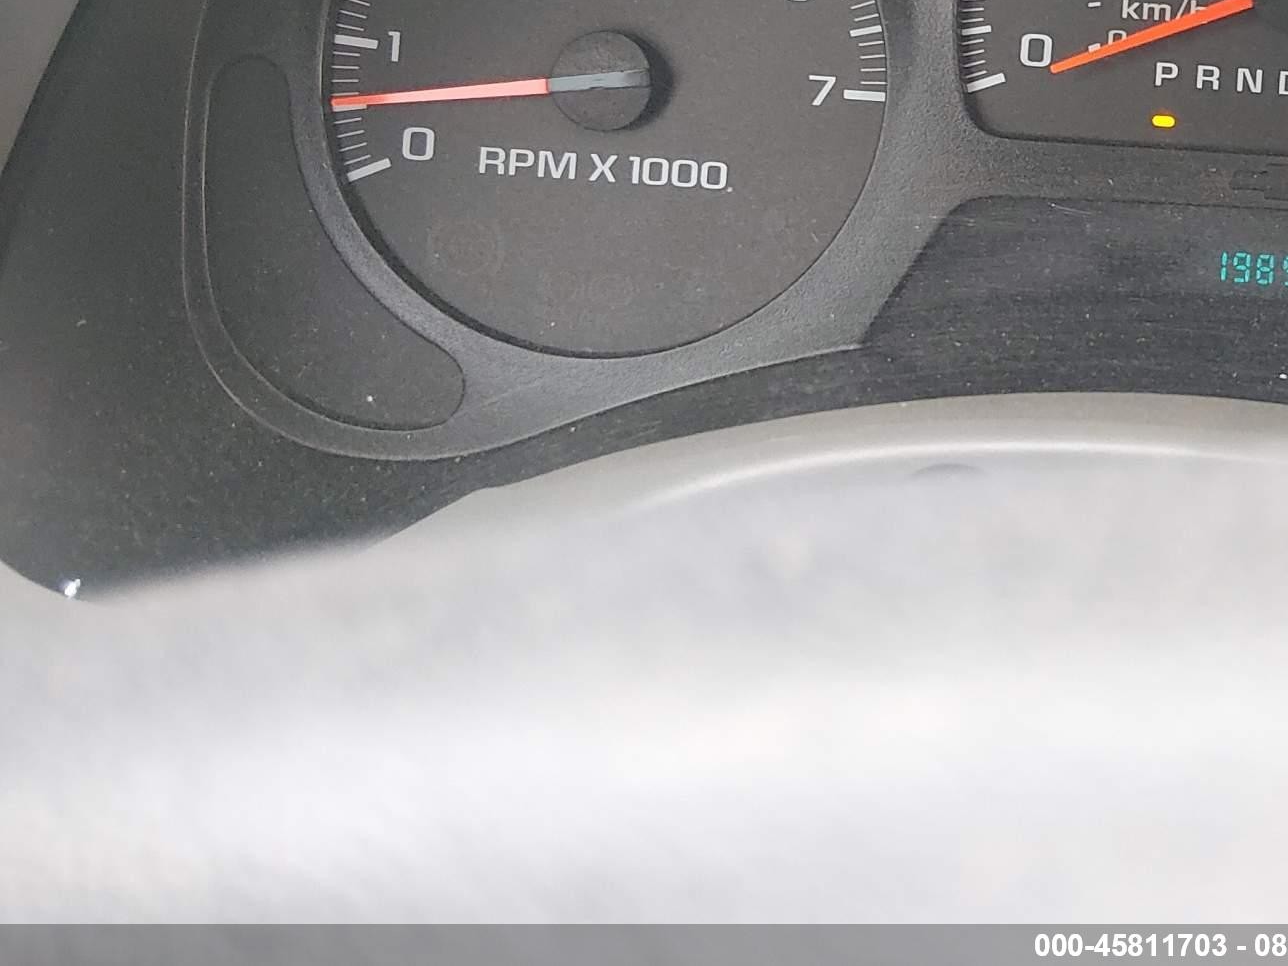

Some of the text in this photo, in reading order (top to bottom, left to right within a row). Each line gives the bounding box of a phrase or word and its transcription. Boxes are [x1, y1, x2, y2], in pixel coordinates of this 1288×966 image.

[388, 31, 400, 61] 1
[1020, 34, 1052, 67] 0
[809, 75, 836, 105] 7
[1156, 62, 1178, 85] P
[1197, 65, 1219, 90] R
[1237, 68, 1262, 93] N
[403, 127, 434, 160] 0
[479, 147, 576, 179] RPM
[589, 154, 617, 182] X
